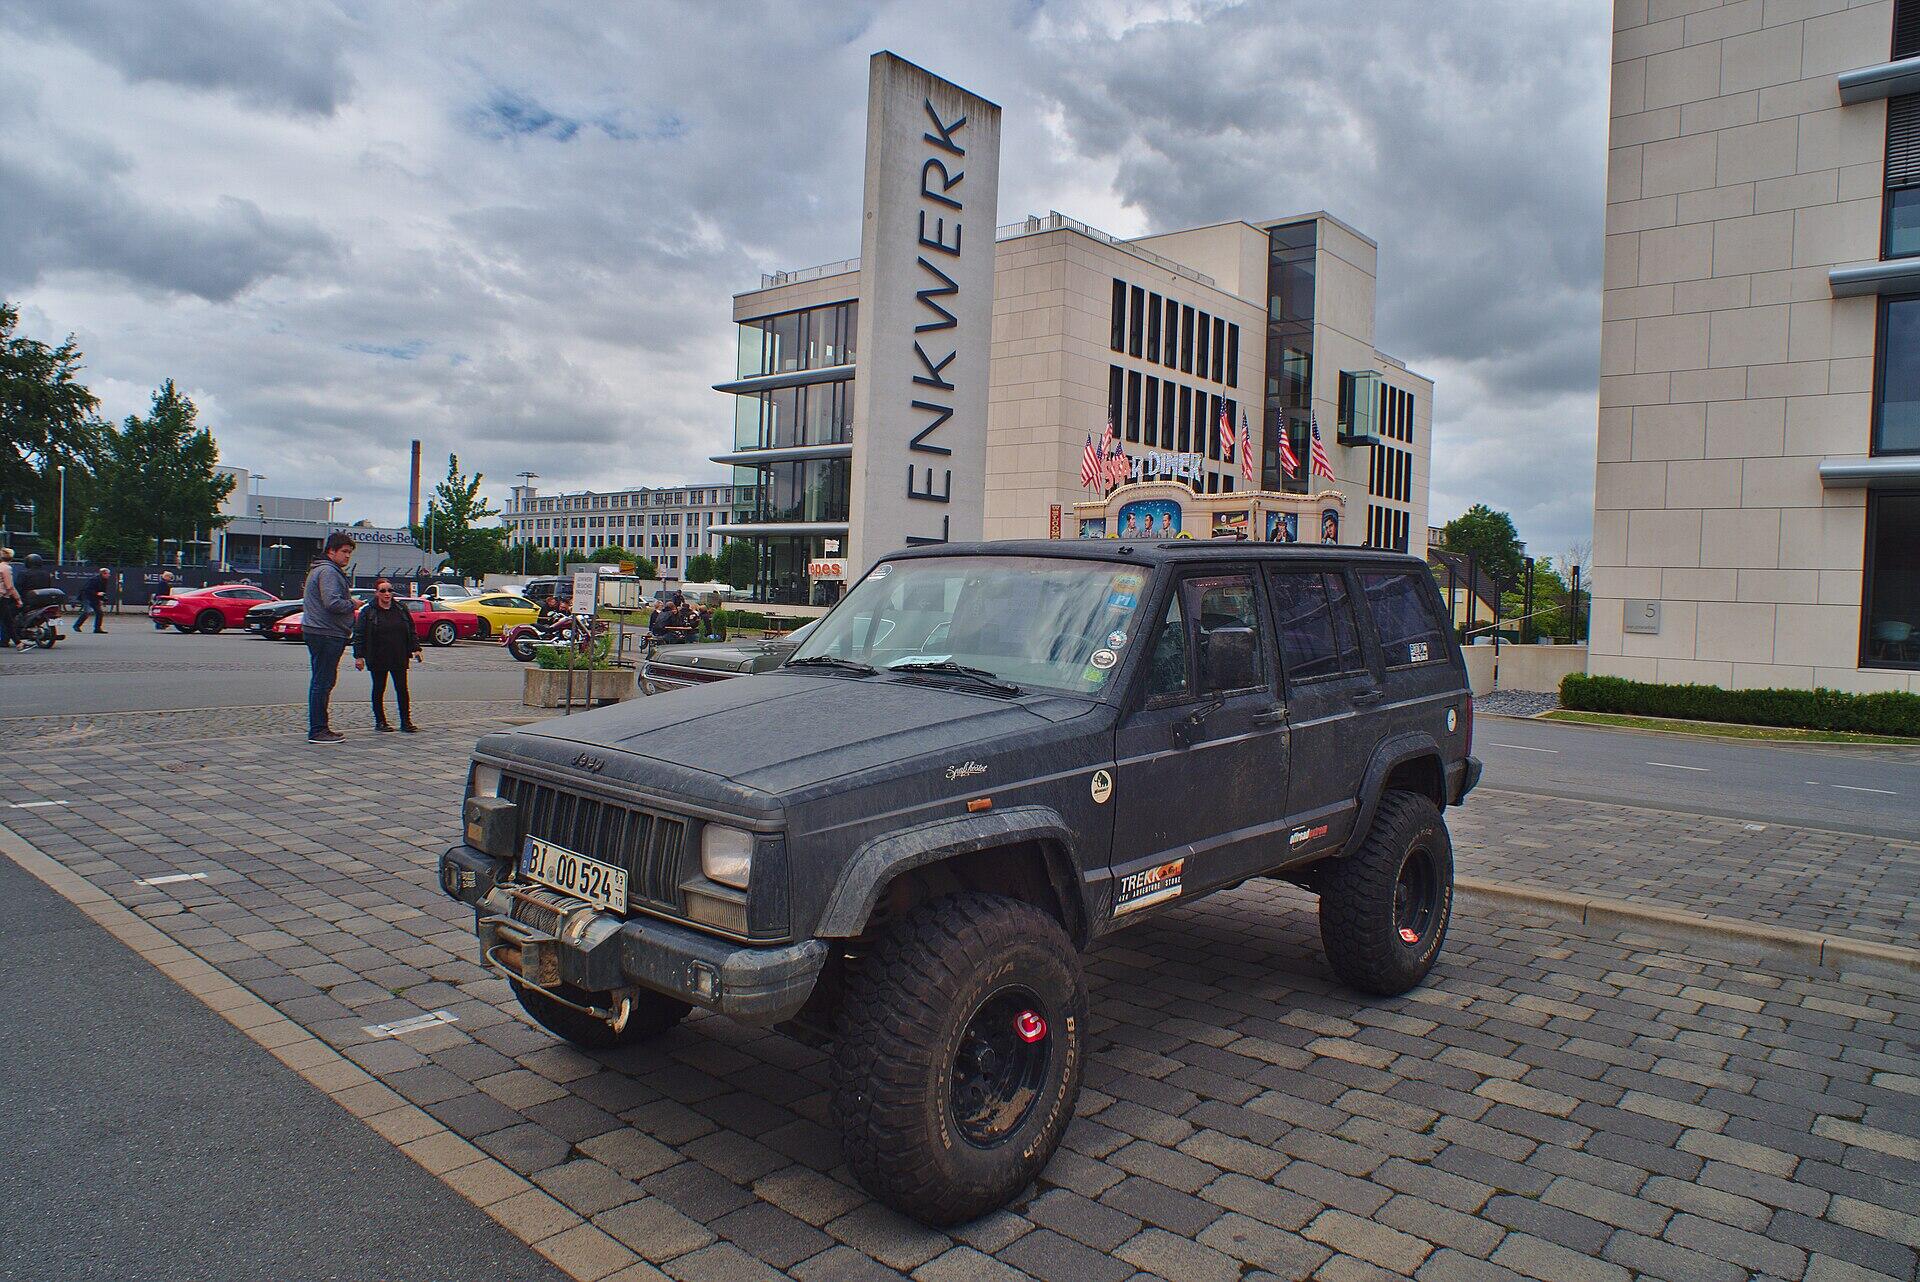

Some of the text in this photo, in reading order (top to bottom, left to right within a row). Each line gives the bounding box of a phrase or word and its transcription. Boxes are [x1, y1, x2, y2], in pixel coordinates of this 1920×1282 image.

[906, 97, 967, 548] LENKWERK
[1146, 451, 1204, 481] DINER
[1645, 603, 1656, 618] 5
[528, 844, 548, 878] BI
[579, 862, 612, 903] 524
[1133, 882, 1161, 898] ADVENTURE
[1165, 876, 1181, 887] STORE
